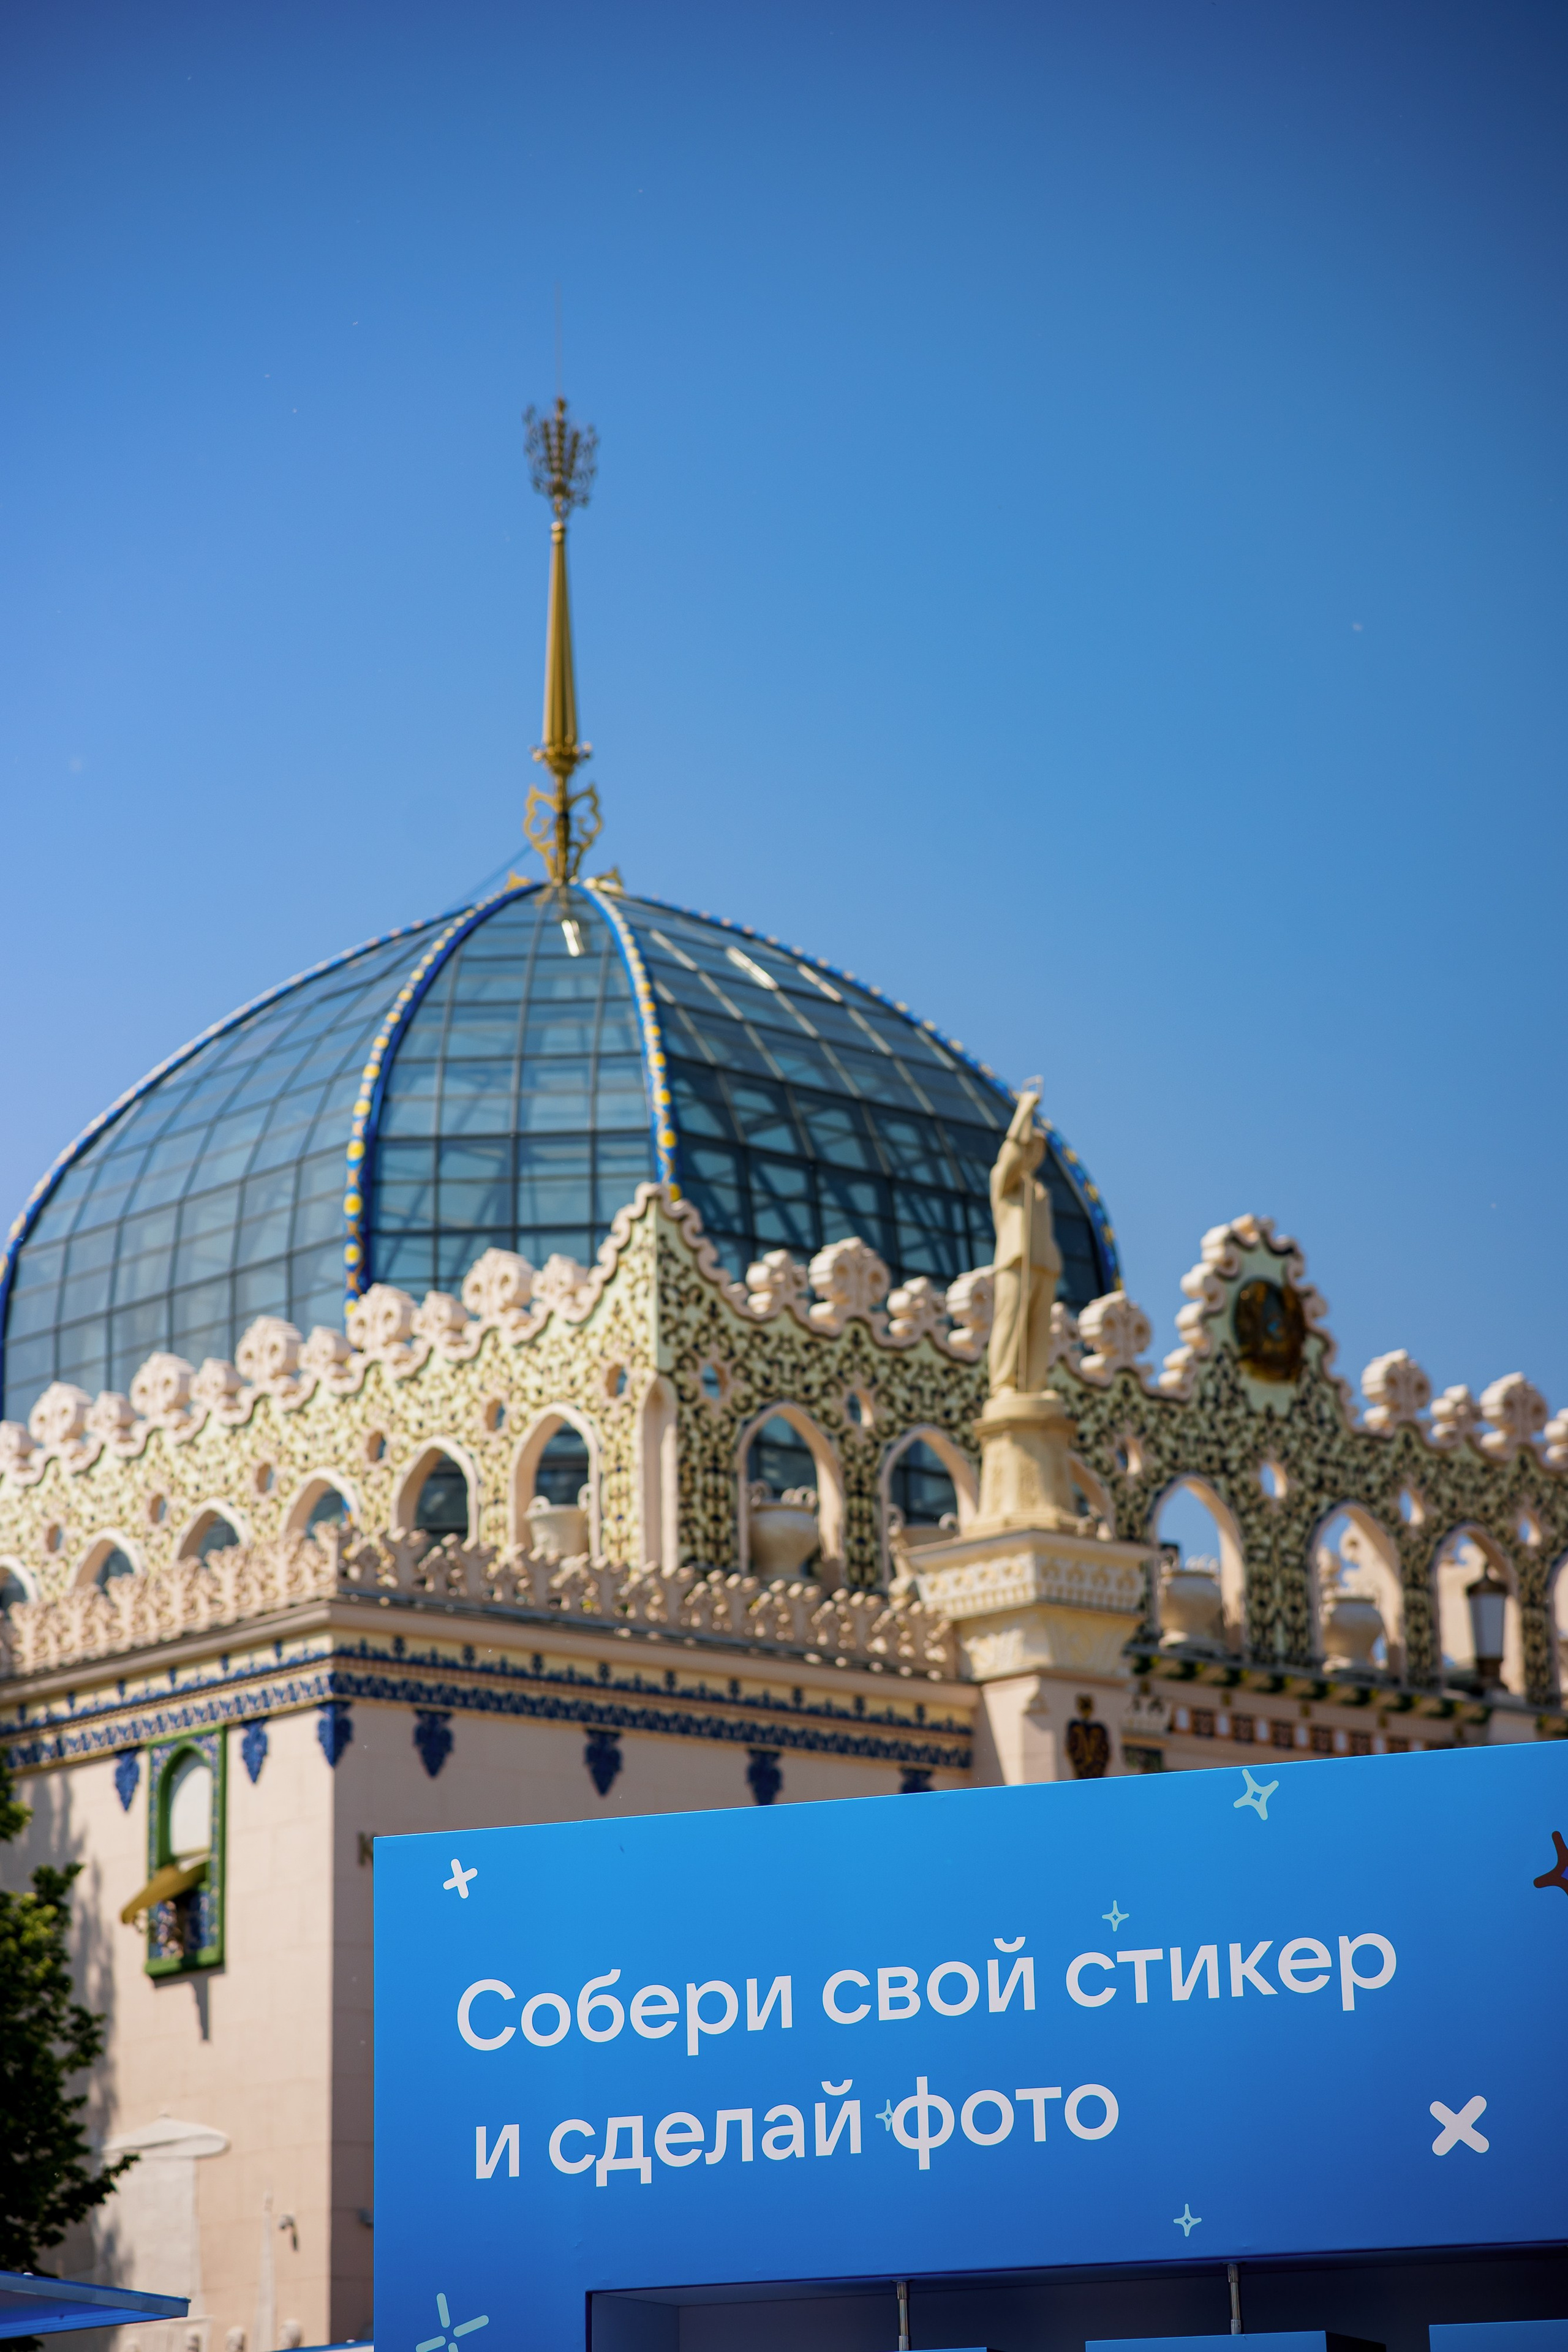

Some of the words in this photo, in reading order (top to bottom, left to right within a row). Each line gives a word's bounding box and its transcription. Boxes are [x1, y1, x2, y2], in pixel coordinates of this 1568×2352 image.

[457, 1968, 793, 2056] Собери
[821, 1937, 1036, 2025] свой
[1066, 1932, 1397, 2011] стикер
[476, 2124, 519, 2179] и
[549, 2079, 862, 2187] сделай
[892, 2076, 1119, 2170] фото
